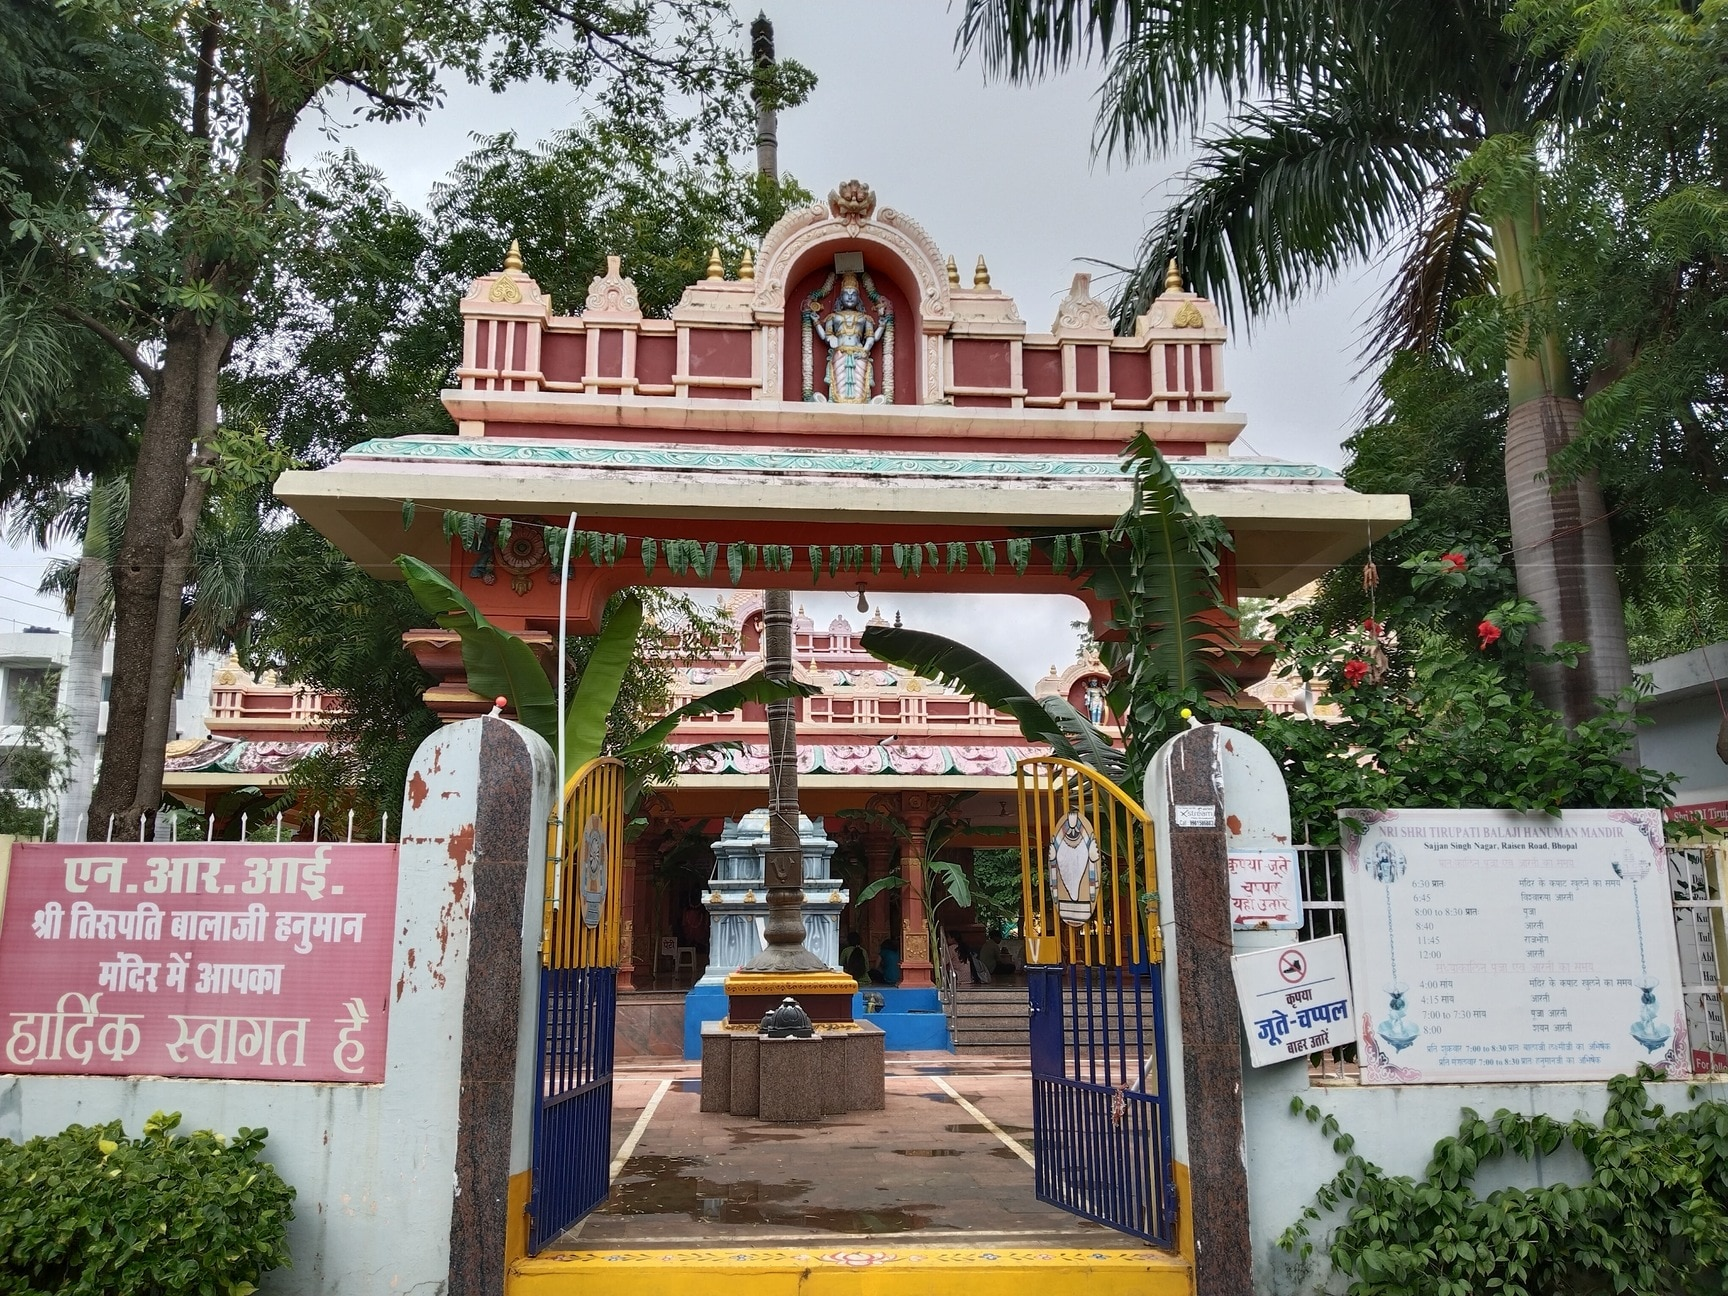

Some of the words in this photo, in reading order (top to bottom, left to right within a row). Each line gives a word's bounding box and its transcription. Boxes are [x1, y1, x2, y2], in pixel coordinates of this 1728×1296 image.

[1379, 826, 1398, 838] NRI
[1401, 826, 1426, 838] SHRI
[1429, 826, 1481, 838] TIRUPATI
[1483, 827, 1520, 838] BALAJI
[1523, 827, 1578, 838] HANUMAN
[1580, 827, 1625, 838] MANDIR
[1424, 842, 1448, 851] Sajjan
[1450, 842, 1472, 851] Singh
[1474, 842, 1500, 851] Nagar,
[1501, 842, 1526, 850] Raisen
[1528, 842, 1550, 850] Road,
[1551, 842, 1578, 851] Bhopal
[1268, 855, 1293, 878] जूते
[1412, 880, 1430, 888] 6:30
[1593, 880, 1602, 888] का
[1605, 880, 1621, 888] समय
[1413, 894, 1431, 902] 6:45
[1555, 891, 1574, 901] आरती
[1415, 908, 1433, 916] 8:00
[1435, 908, 1443, 916] to
[1445, 908, 1463, 916] 8:30
[1523, 907, 1536, 919] पूजा
[32, 901, 64, 939] श्री
[171, 903, 269, 942] बालाजी
[275, 912, 366, 954] हनुमान
[1416, 922, 1434, 930] 8:40
[1525, 920, 1544, 930] आरती
[1418, 936, 1440, 945] 11:45
[1419, 950, 1442, 959] 12:00
[1526, 948, 1544, 958] आरती
[99, 952, 161, 992] मंदिर
[166, 952, 192, 993] में
[195, 963, 285, 994] आपका
[1419, 980, 1438, 989] 4:00
[1604, 979, 1613, 988] का
[1616, 979, 1633, 987] समय
[1285, 988, 1313, 1008] कृपया
[1421, 995, 1439, 1004] 4:15
[1531, 993, 1550, 1003] आरती
[1422, 1010, 1440, 1019] 7:00
[1442, 1010, 1451, 1019] to
[1453, 1010, 1471, 1019] 7:30
[1531, 1009, 1544, 1020] पूजा
[1548, 1007, 1568, 1018] आरती
[1254, 999, 1348, 1046] जूते-चप्पल
[1553, 1022, 1573, 1032] आरती
[6, 992, 144, 1066] हार्दिक
[166, 1014, 310, 1067] स्वागत
[333, 998, 369, 1074] है
[1423, 1025, 1442, 1034] 8:00
[1286, 1038, 1308, 1054] बाहर
[1309, 1028, 1330, 1049] उतारें
[1466, 1045, 1481, 1053] 7:00
[1483, 1045, 1490, 1053] to
[1491, 1044, 1507, 1052] 8:30
[1479, 1057, 1494, 1066] 7:00
[1496, 1057, 1503, 1066] to
[1504, 1056, 1520, 1066] 8:30
[1696, 1058, 1709, 1069] For
